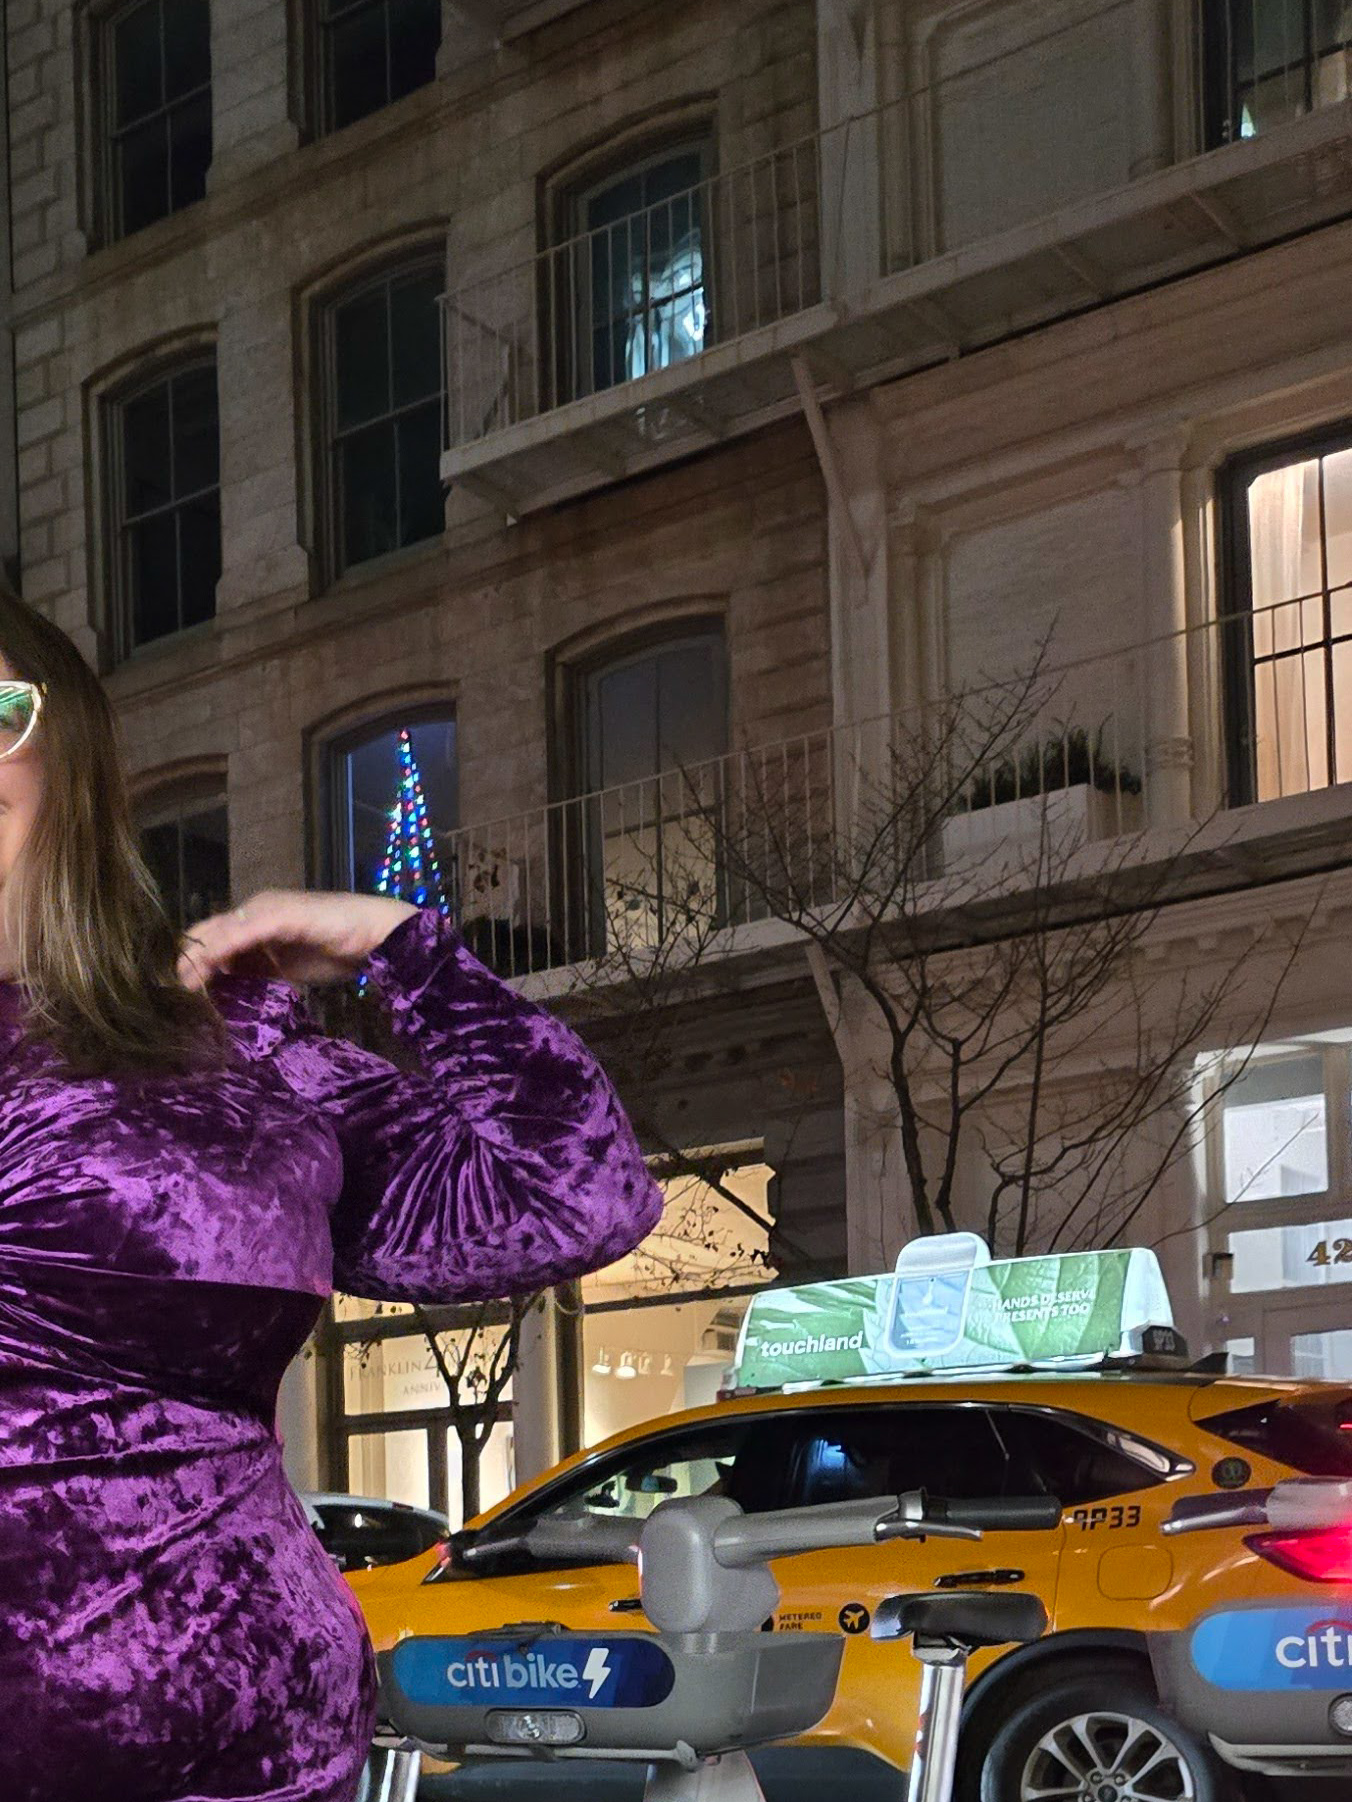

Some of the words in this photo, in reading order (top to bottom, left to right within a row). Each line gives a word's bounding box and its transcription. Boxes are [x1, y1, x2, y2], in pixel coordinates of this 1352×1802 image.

[992, 1294, 1039, 1311] HANDS
[1059, 1302, 1091, 1317] TOO
[760, 1330, 864, 1358] touchland
[779, 1622, 804, 1631] FARE
[446, 1652, 499, 1688] citi
[502, 1652, 580, 1689] bike
